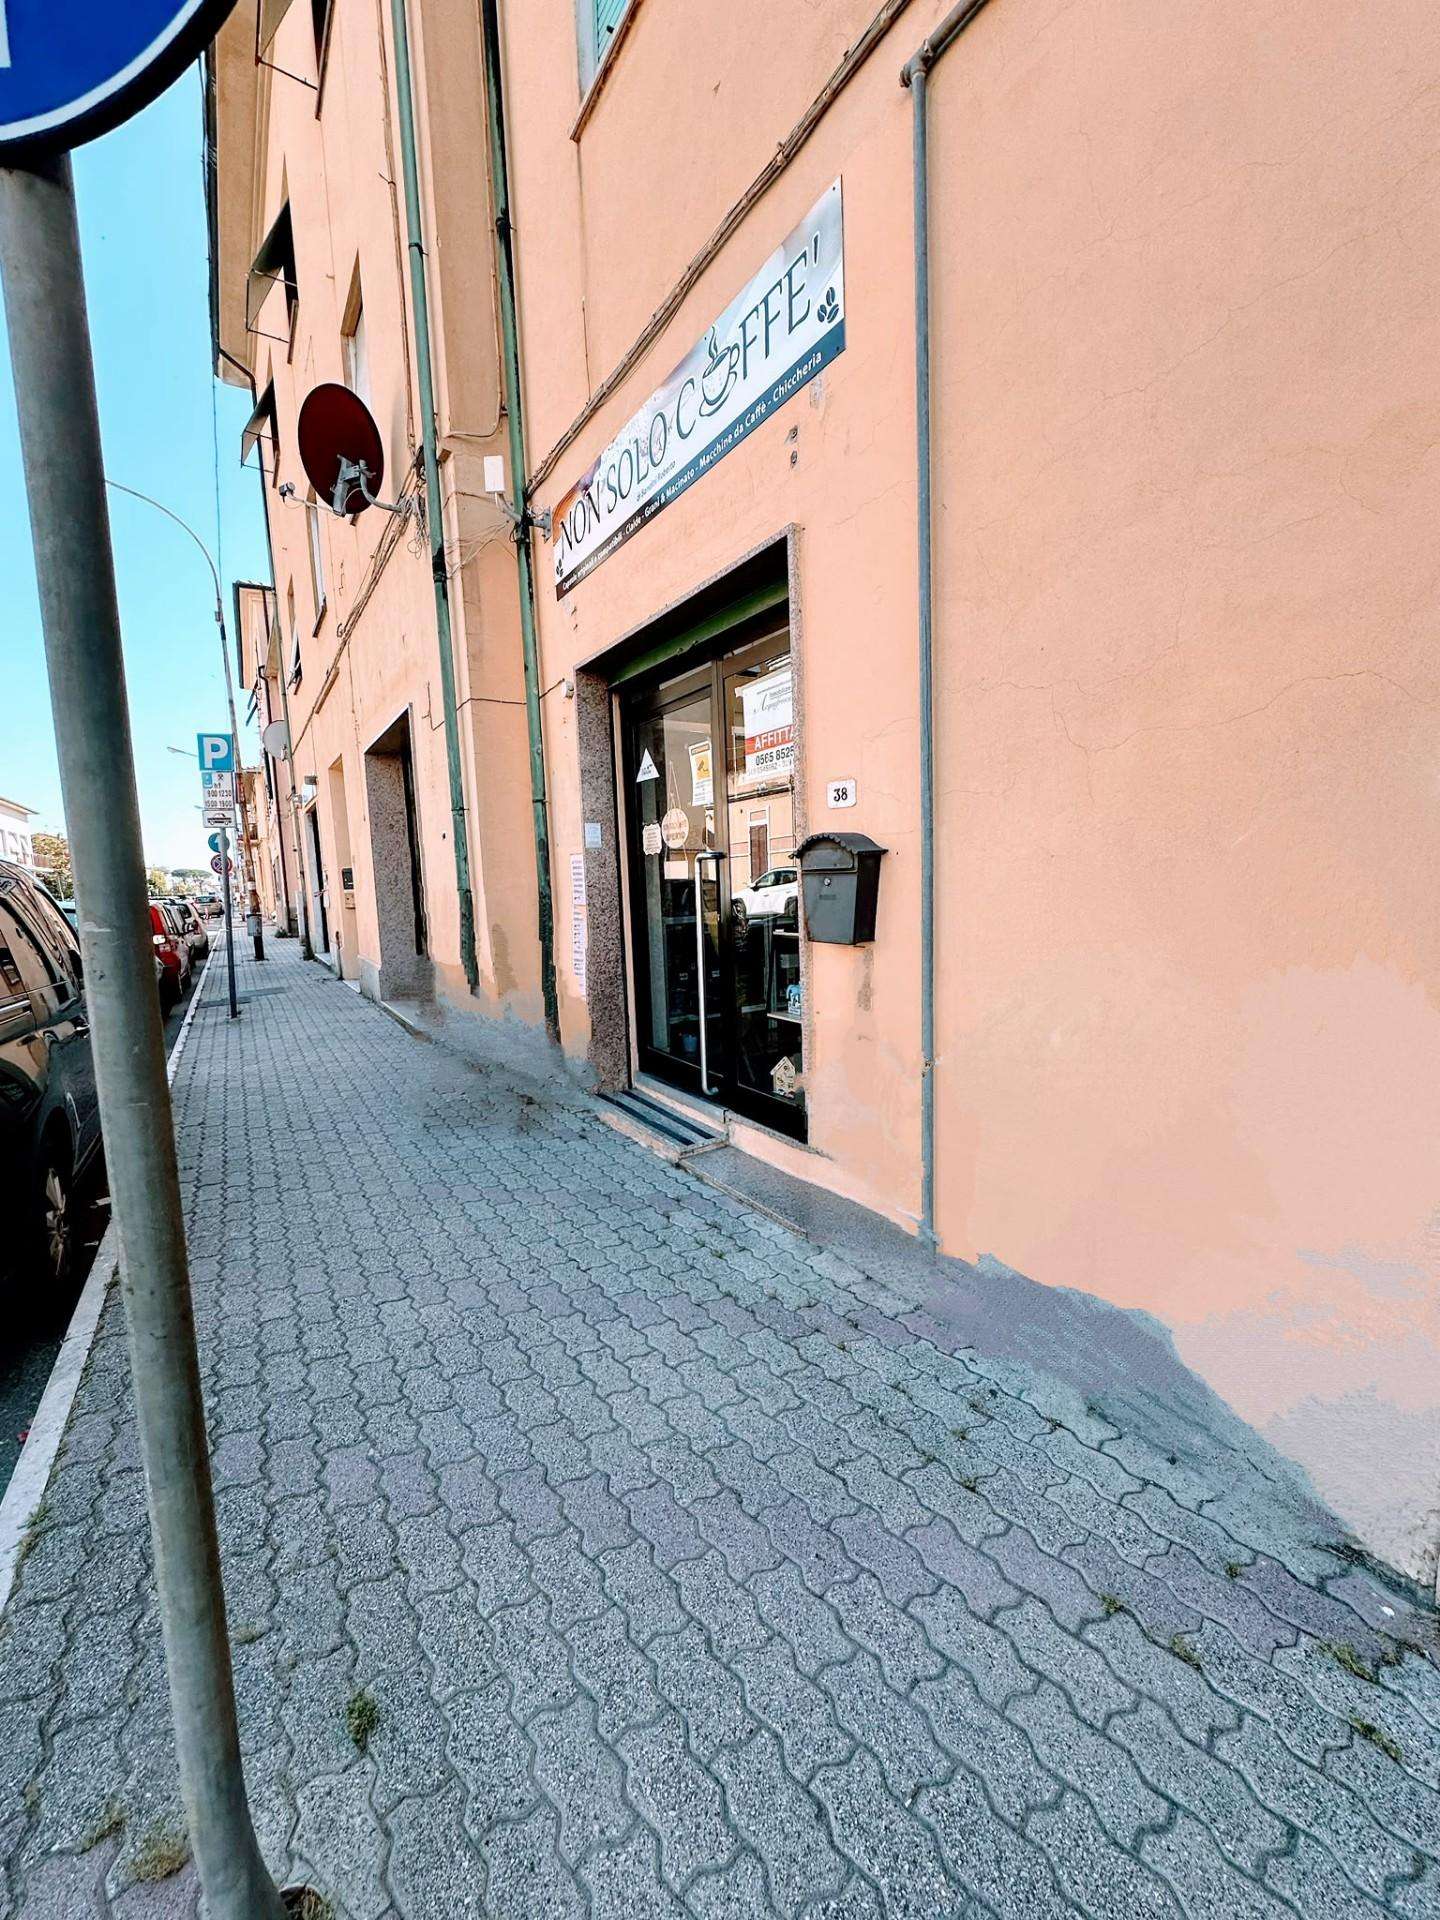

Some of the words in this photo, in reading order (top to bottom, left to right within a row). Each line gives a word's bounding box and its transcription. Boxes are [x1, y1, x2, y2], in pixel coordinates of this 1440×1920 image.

[665, 468, 695, 500] Macinato
[699, 432, 732, 470] Macchine
[733, 423, 744, 438] da
[745, 401, 767, 427] Caffè
[773, 351, 822, 402] Chiccheria
[560, 480, 601, 560] NON
[606, 411, 668, 514] SOLO
[203, 736, 229, 769] P
[755, 751, 774, 766] 0565
[833, 787, 848, 802] 38
